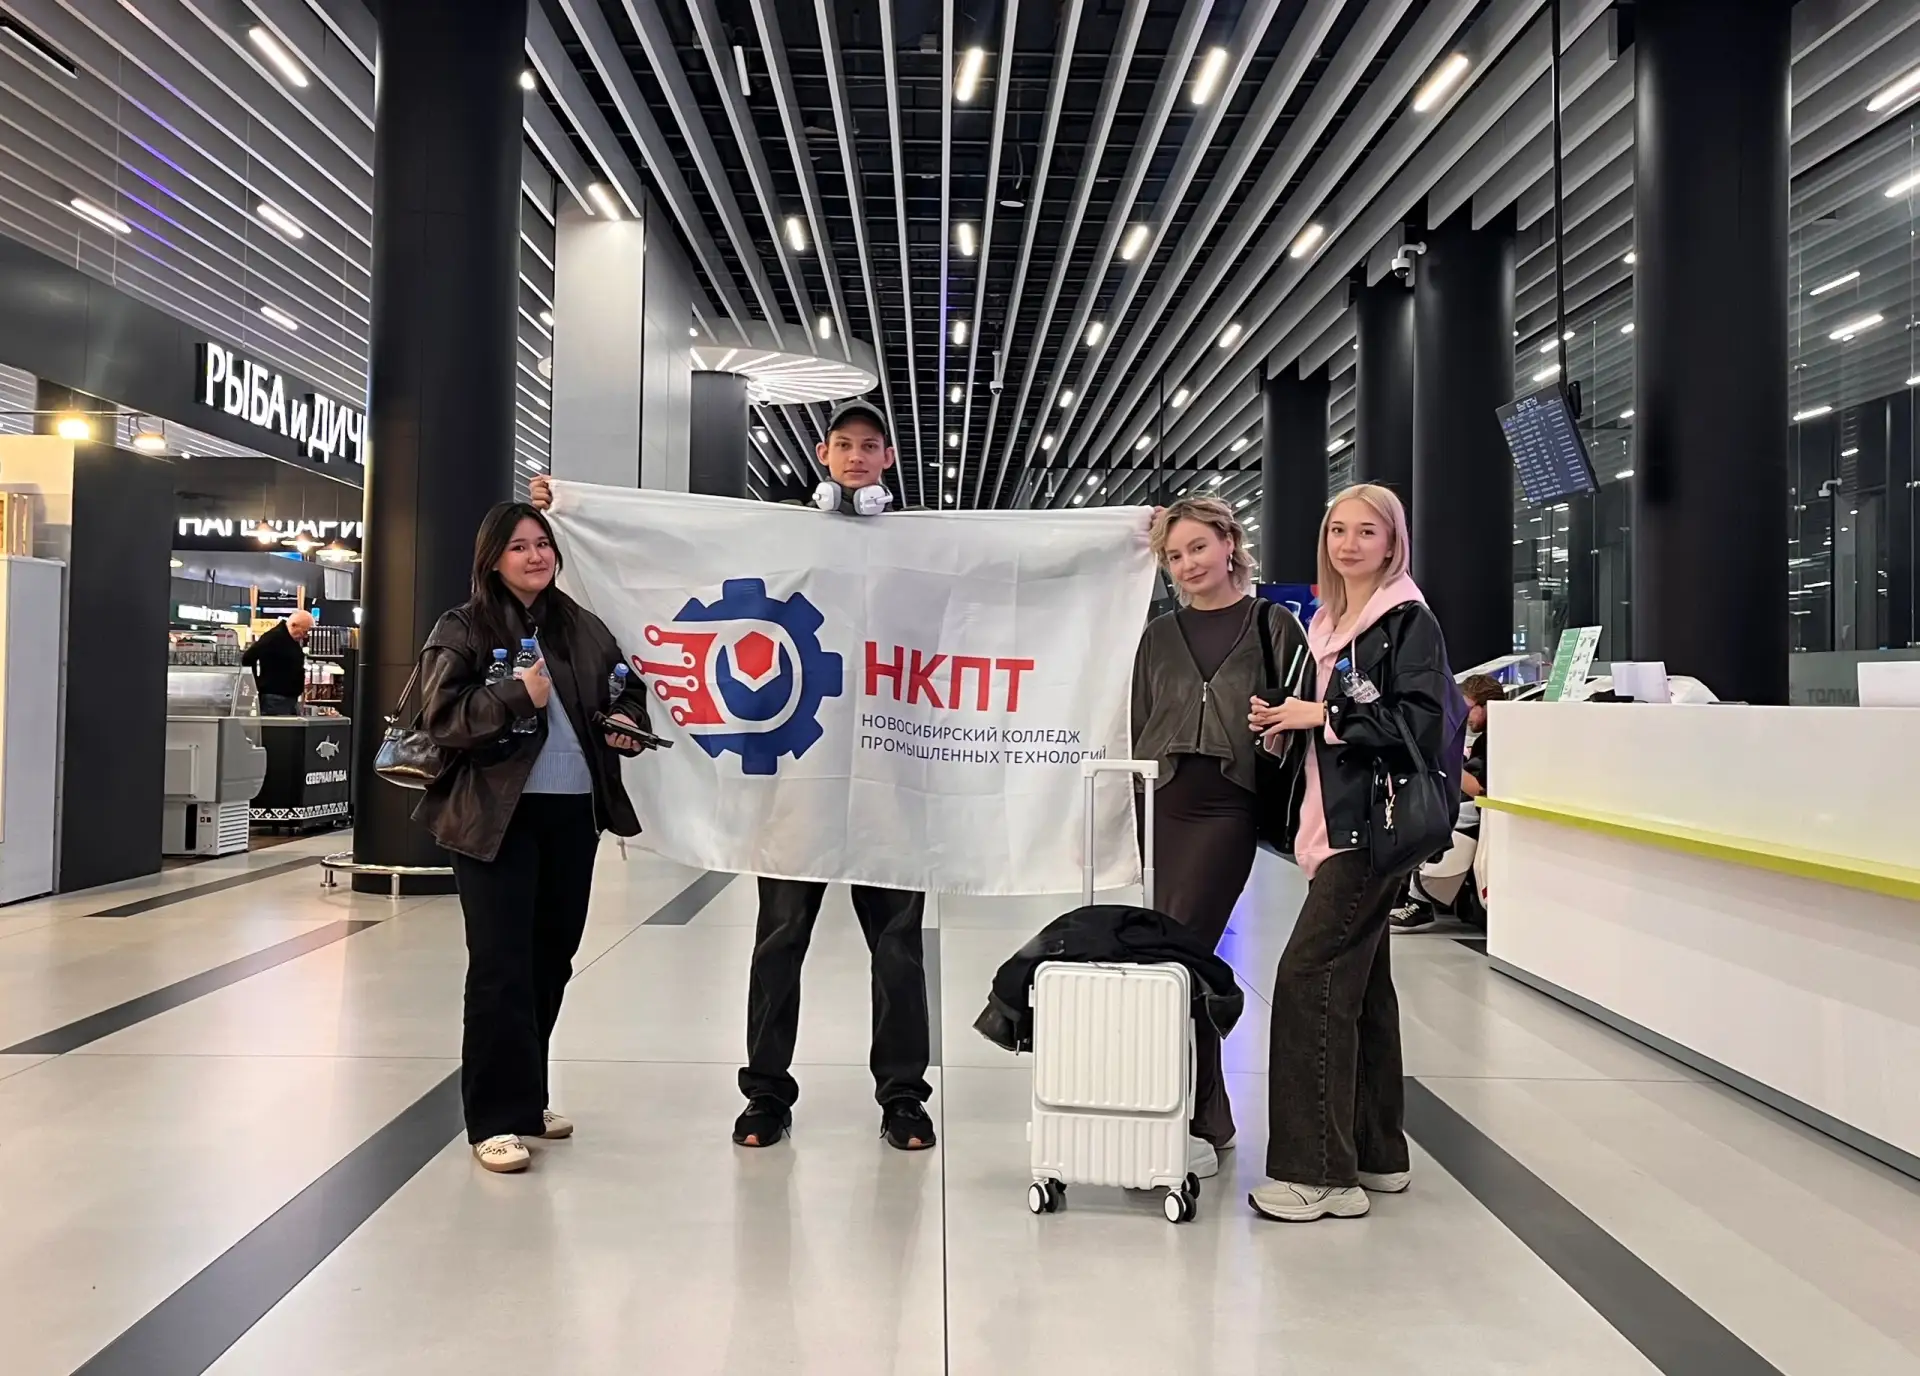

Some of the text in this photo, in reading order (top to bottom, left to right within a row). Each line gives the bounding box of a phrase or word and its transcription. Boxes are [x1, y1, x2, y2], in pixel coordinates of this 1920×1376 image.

[205, 342, 288, 436] РЫБА
[291, 398, 308, 443] и
[865, 641, 1034, 712] НКПТ
[860, 735, 1106, 764] ПРОМЫШЛЕННЫХ ТЕХНОЛОГИЙ
[861, 713, 1081, 745] НОВОСИБИРСКИЙ КОЛЛЕДЖ
